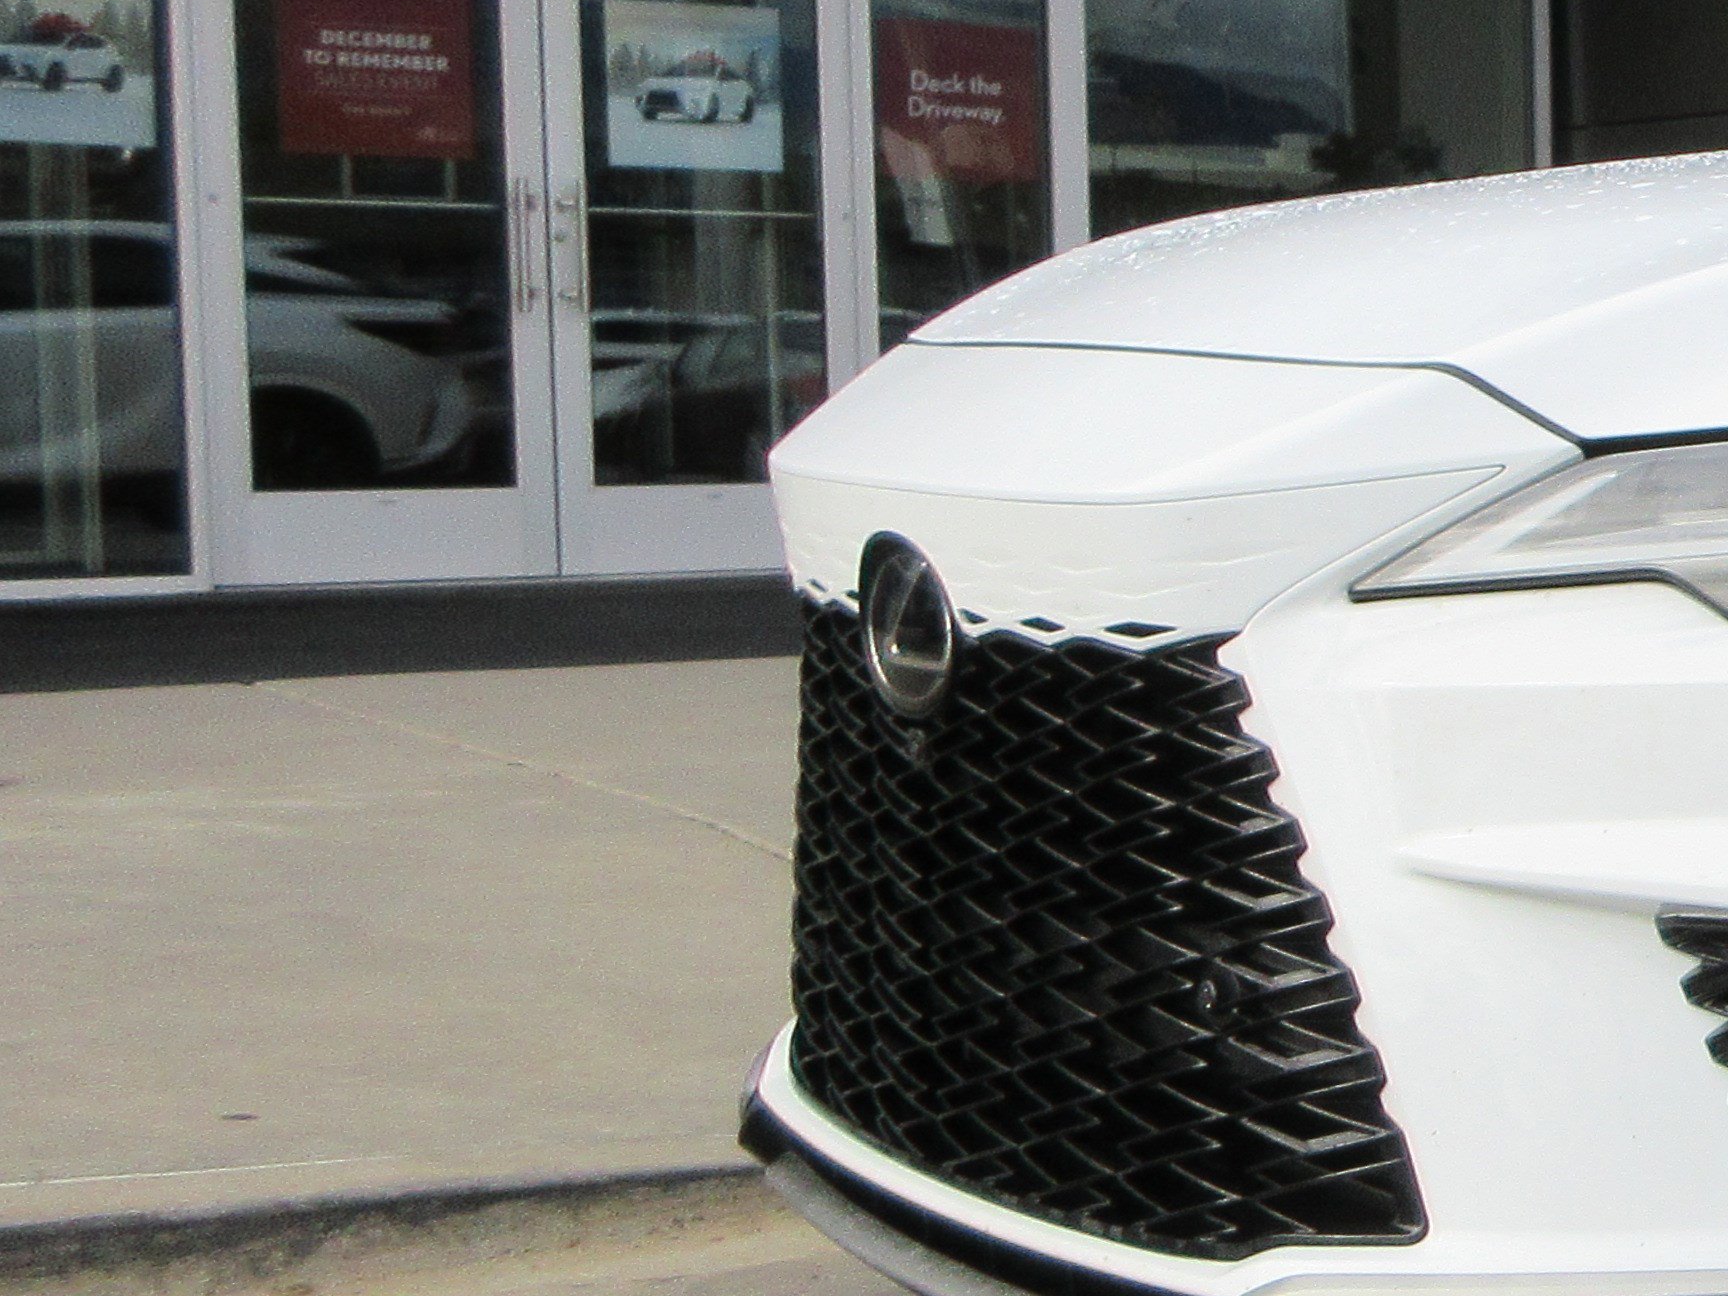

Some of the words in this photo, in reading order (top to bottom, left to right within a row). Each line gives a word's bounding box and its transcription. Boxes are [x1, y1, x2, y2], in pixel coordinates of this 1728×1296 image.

[320, 29, 433, 50] DECEMBER
[303, 49, 333, 65] TO
[336, 51, 450, 73] REMEMBER
[910, 69, 965, 93] Deck
[970, 72, 1002, 96] the
